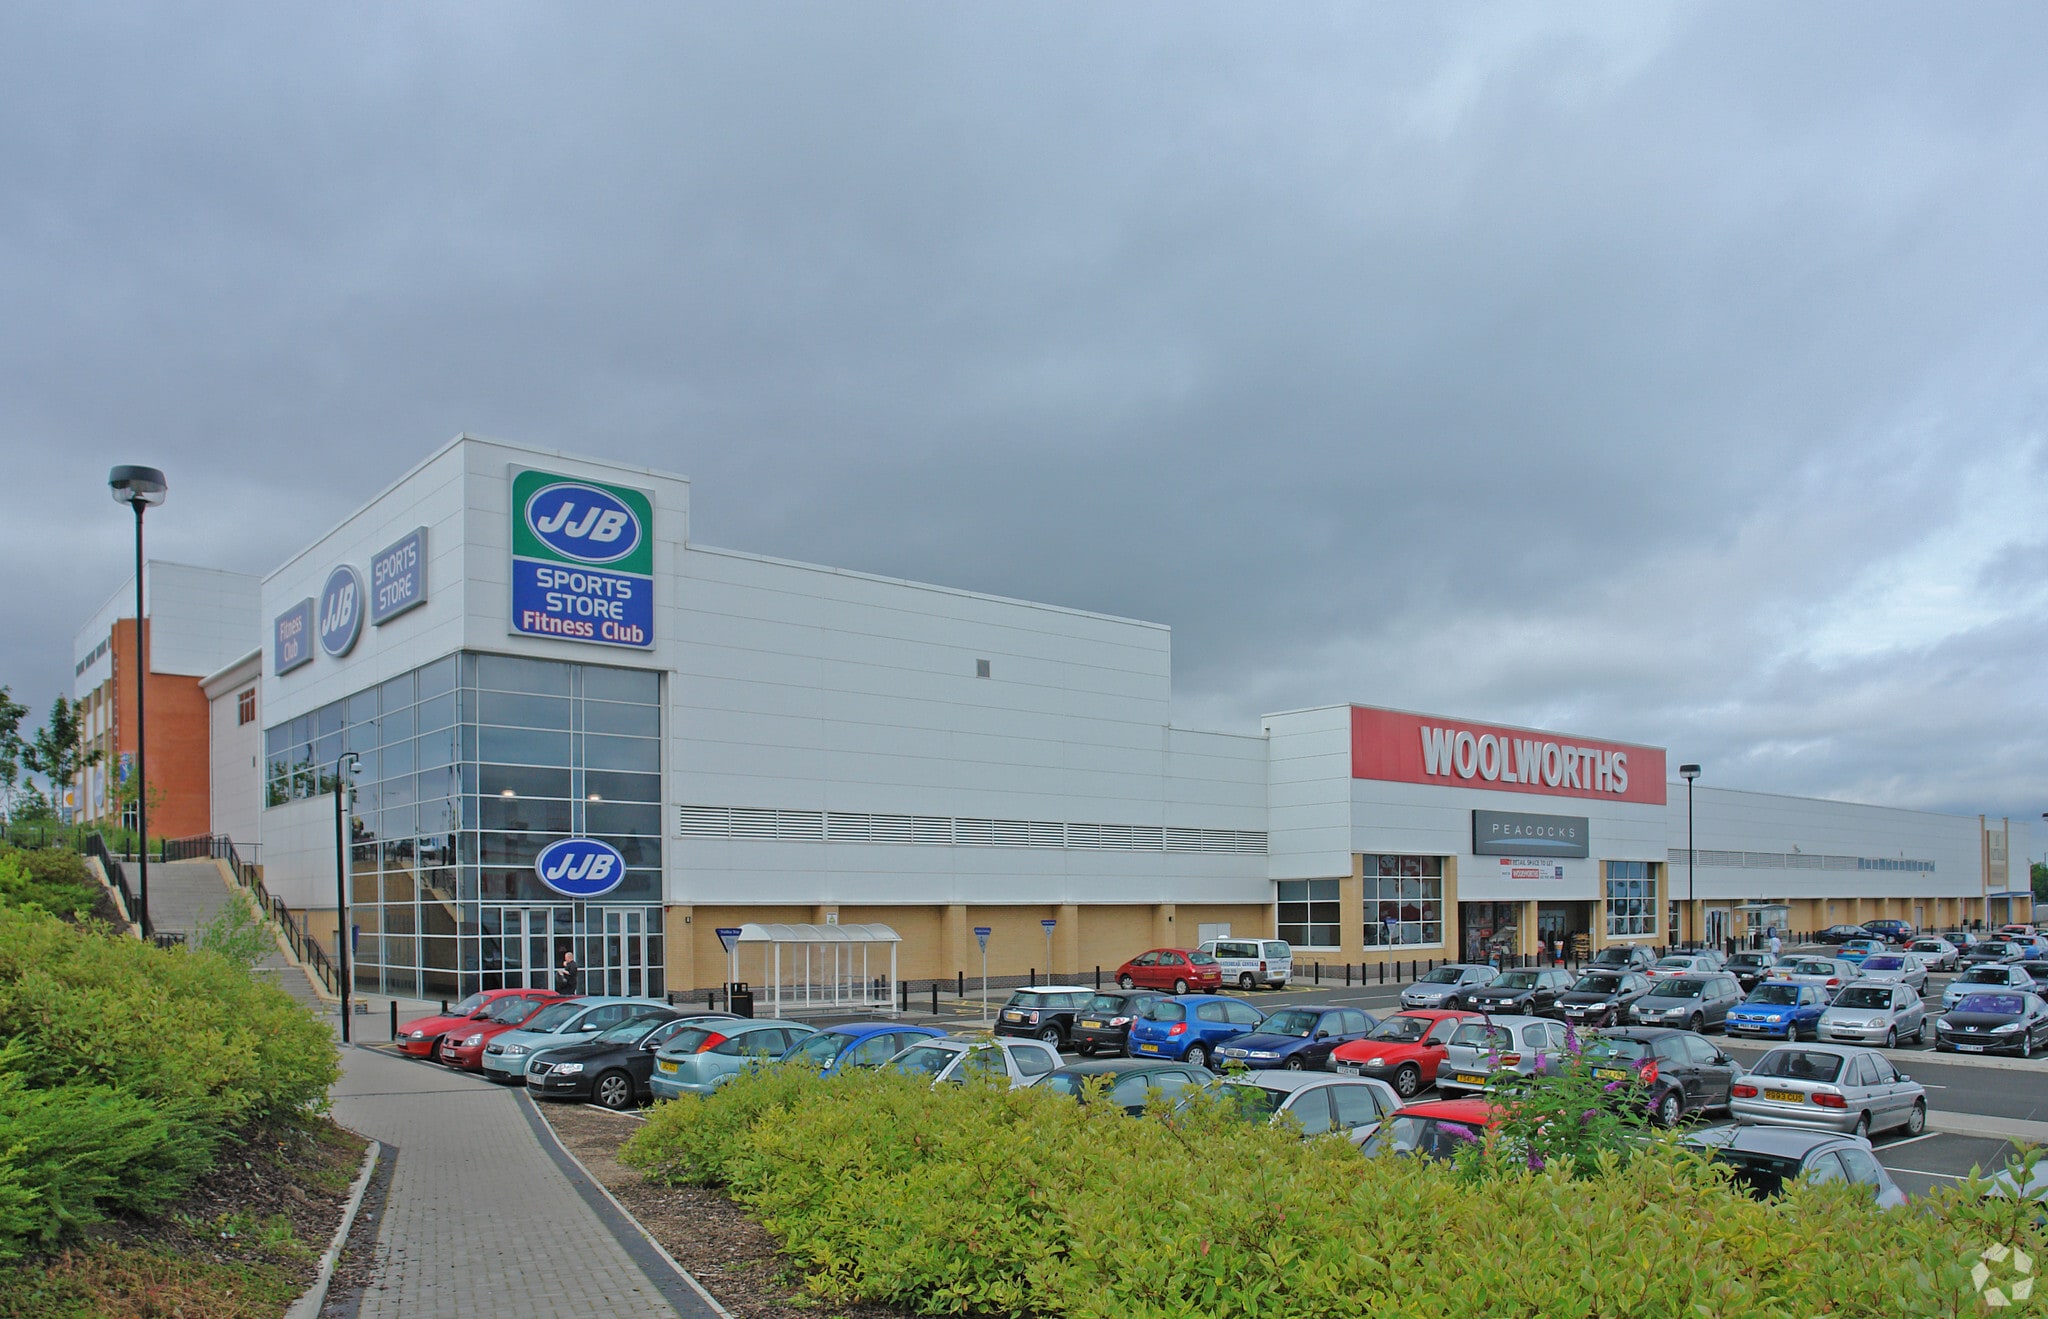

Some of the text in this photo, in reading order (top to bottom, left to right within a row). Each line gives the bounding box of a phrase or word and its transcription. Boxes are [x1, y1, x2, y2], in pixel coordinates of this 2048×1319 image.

[537, 501, 628, 543] JJB
[376, 541, 417, 587] SPORTS
[379, 573, 412, 611] STORE
[536, 567, 632, 600] SPORTS
[321, 582, 355, 637] JJB
[546, 591, 624, 620] STORE
[279, 615, 303, 643] Fitness
[522, 610, 644, 643] Fitness Club
[283, 638, 299, 663] Club
[1420, 726, 1629, 794] WOOLWORTHS
[1492, 823, 1576, 838] PEACOCKS
[546, 853, 616, 880] JJB
